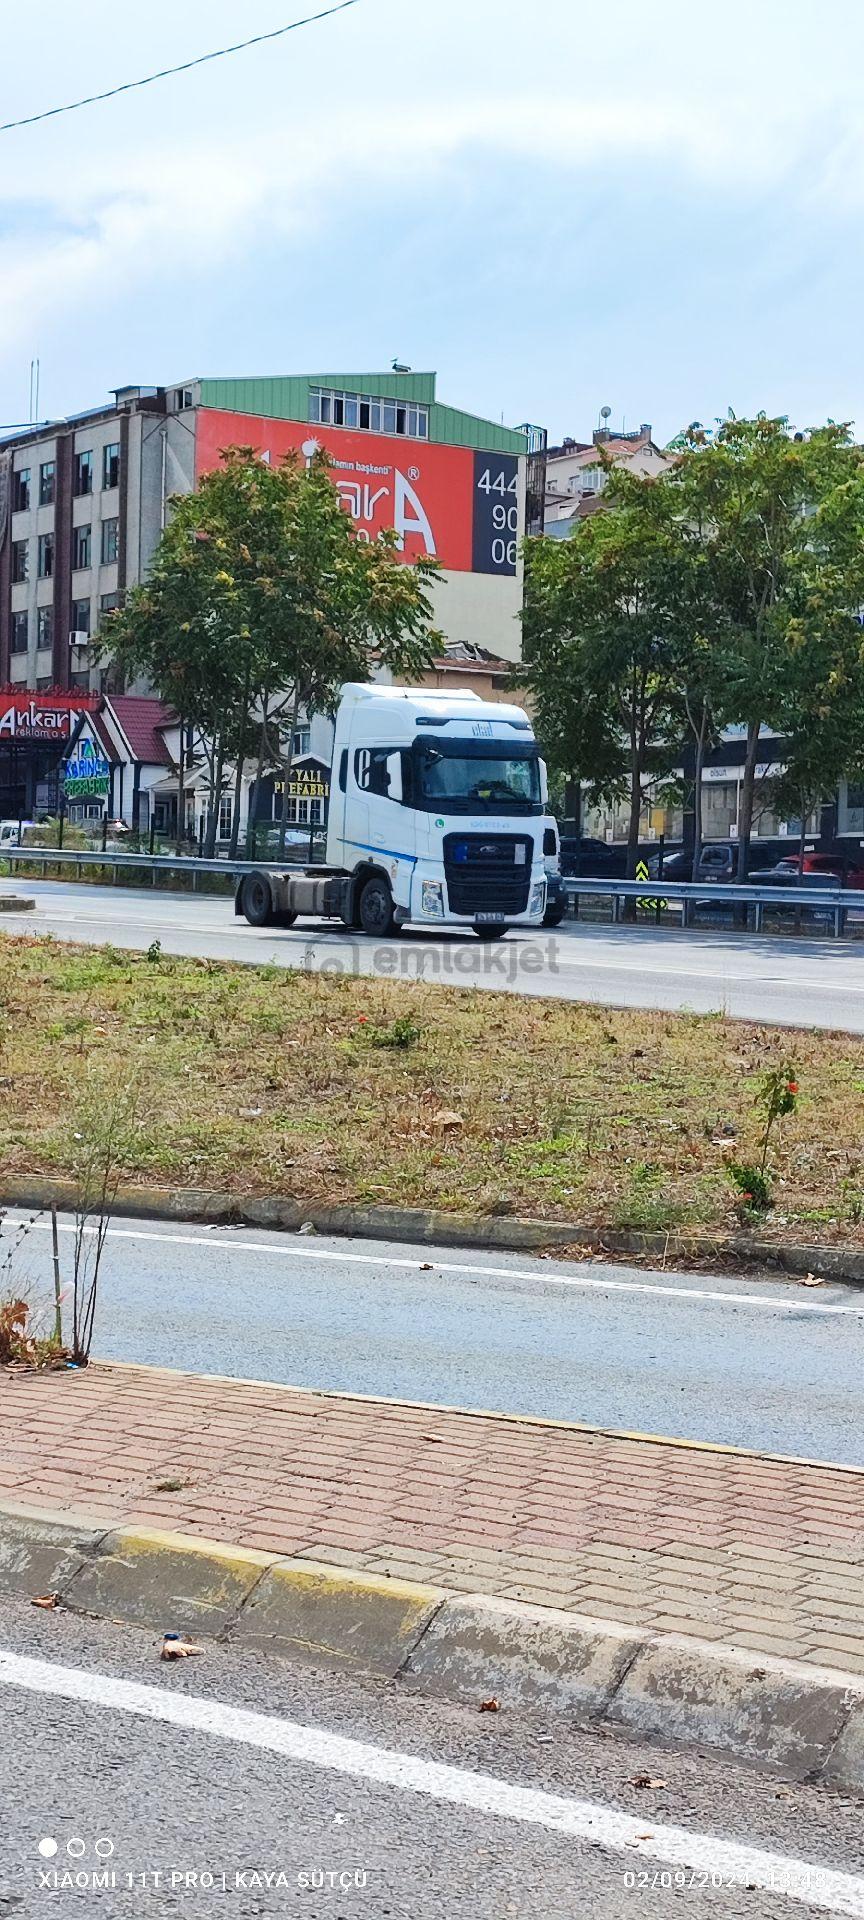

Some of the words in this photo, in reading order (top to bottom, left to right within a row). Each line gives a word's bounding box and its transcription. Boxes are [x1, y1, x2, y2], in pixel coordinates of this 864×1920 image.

[477, 468, 518, 497] 444
[492, 504, 518, 532] 90
[491, 538, 517, 566] 06
[15, 727, 49, 738] reklam
[295, 768, 322, 783] YALI
[273, 780, 330, 797] PEFABRİ
